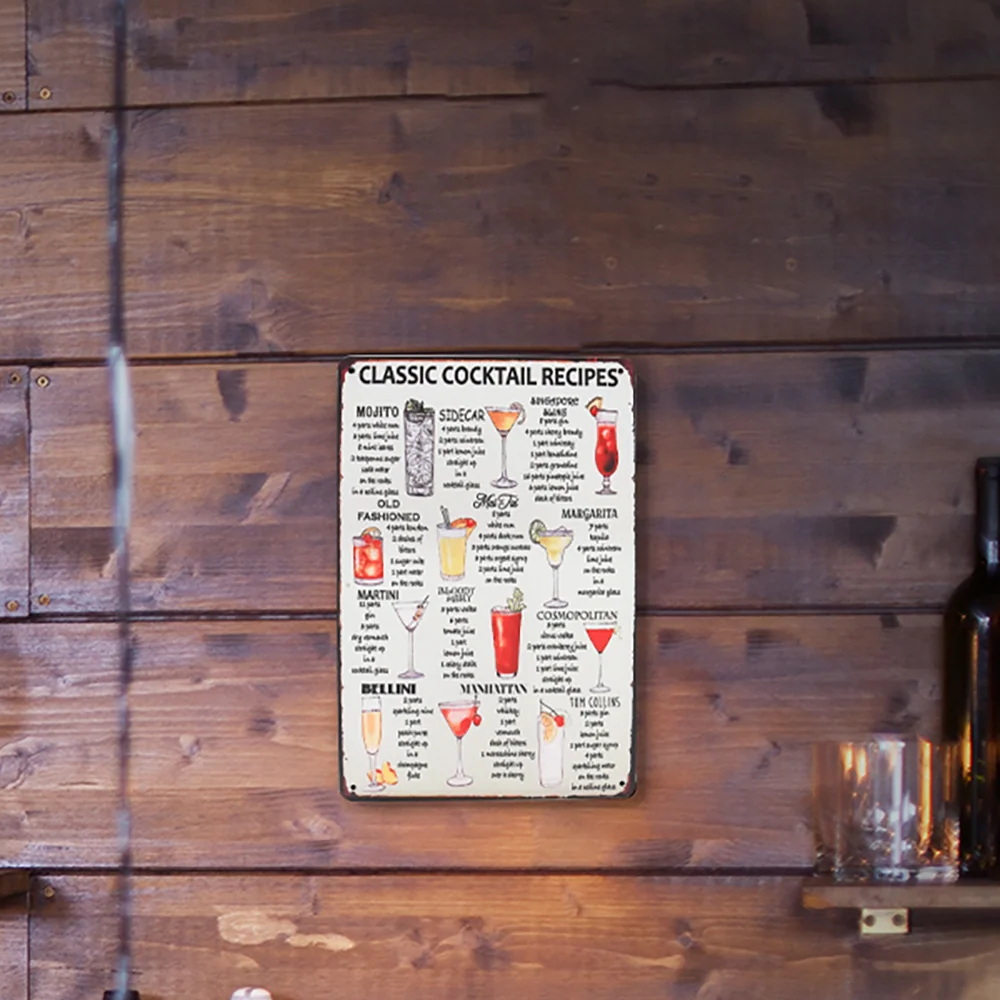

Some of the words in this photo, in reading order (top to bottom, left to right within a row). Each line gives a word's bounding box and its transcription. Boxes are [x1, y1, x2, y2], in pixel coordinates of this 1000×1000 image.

[359, 365, 437, 385] CLASSIC
[442, 366, 537, 386] COCKTAIL
[542, 367, 619, 387] RECIPES
[356, 406, 399, 418] MOJITO
[439, 408, 485, 422] SIDECAR
[377, 499, 400, 509] OLD
[358, 512, 420, 522] FASHIONED
[561, 508, 618, 521] MARGARITA
[357, 590, 399, 600] MARTINI
[536, 611, 617, 620] COSMOPOLITAN
[361, 683, 416, 695] BELLINI
[460, 684, 527, 695] MANHATTAN
